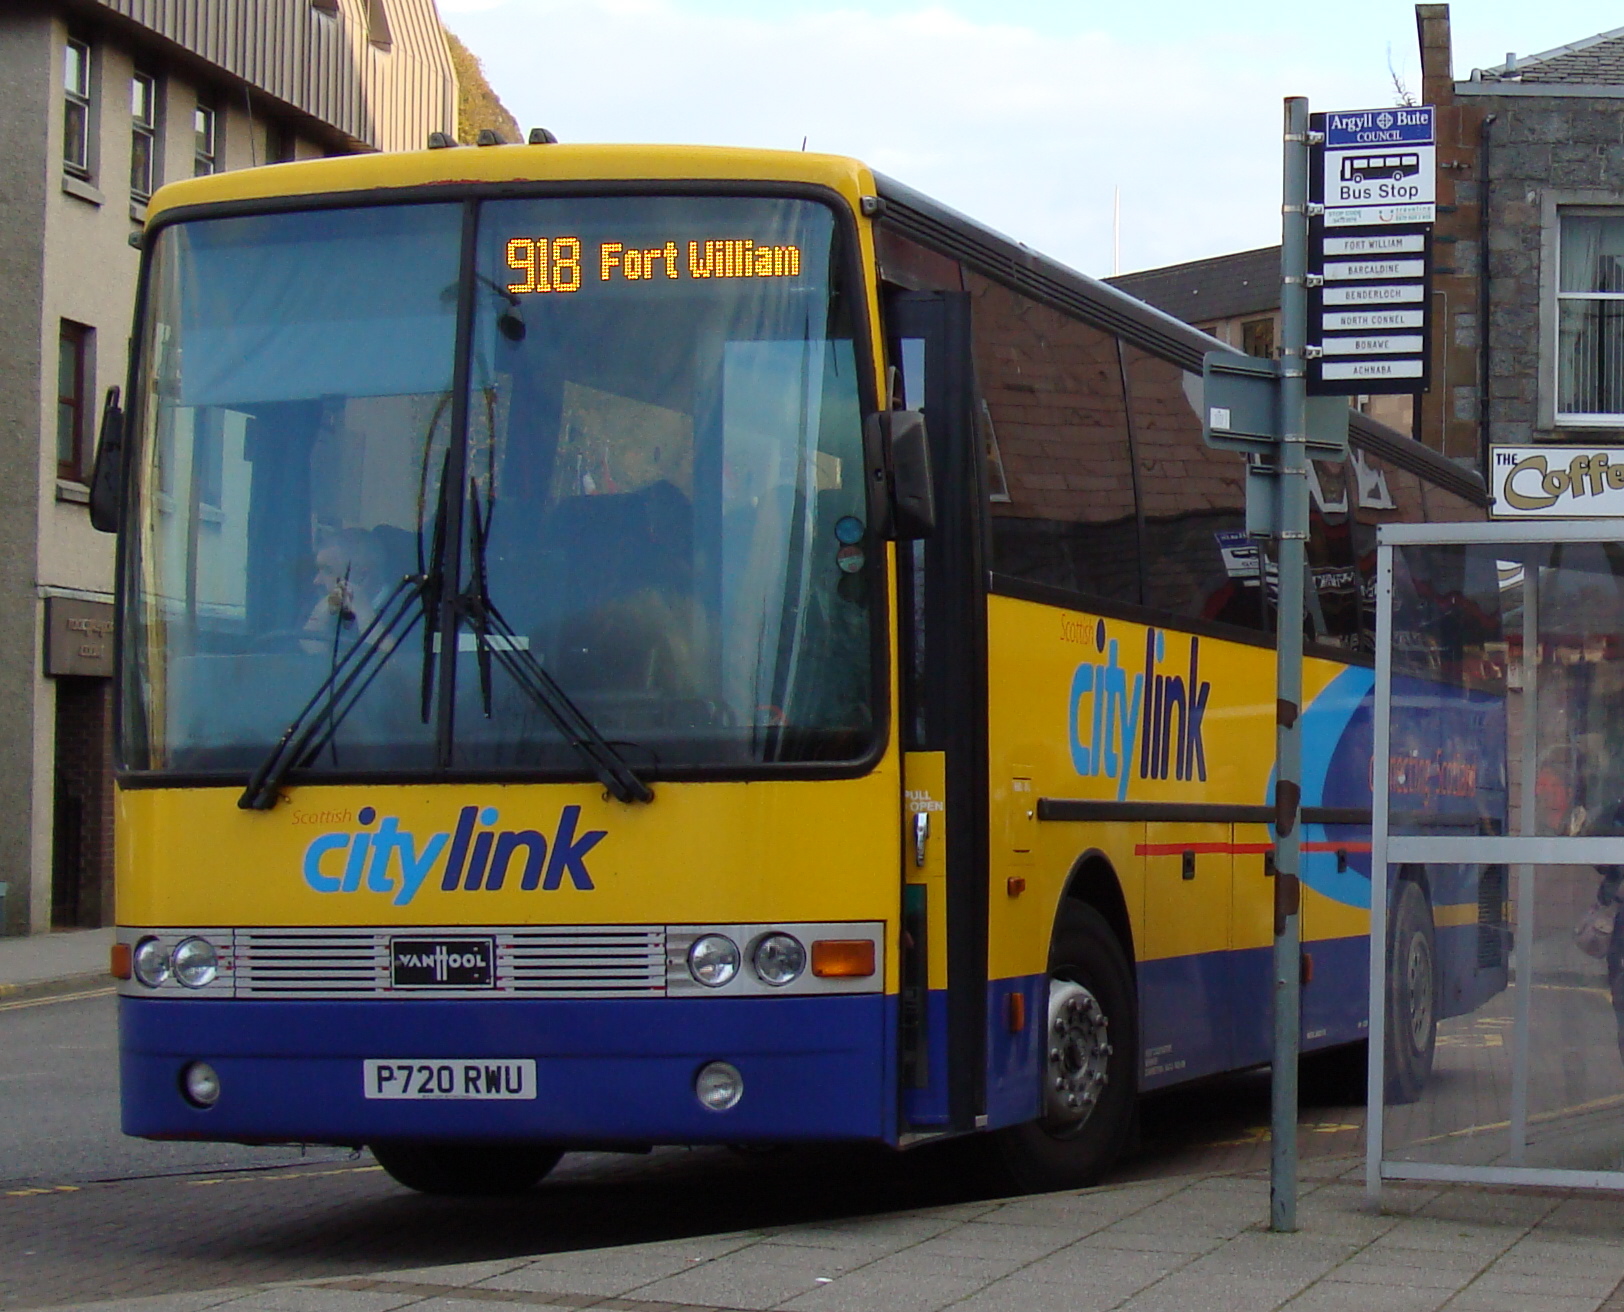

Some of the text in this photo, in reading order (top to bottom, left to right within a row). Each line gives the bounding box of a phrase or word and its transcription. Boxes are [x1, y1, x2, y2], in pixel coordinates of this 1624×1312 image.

[1331, 111, 1429, 132] Argyll Bute
[1356, 130, 1403, 142] COUNCIL
[1340, 183, 1419, 200] Bus Stop
[1344, 238, 1403, 250] FORT WILLIAM
[506, 237, 581, 293] 918
[600, 239, 800, 280] Fort William
[1348, 264, 1400, 275] BARCALDINE
[1345, 289, 1402, 300] BENDERLOCH
[1340, 314, 1405, 325] NORTH CONNEL
[1355, 340, 1389, 350] BONAWE
[1353, 365, 1392, 375] ACHNABA
[1496, 453, 1518, 466] THE
[1060, 613, 1094, 645] Scottish
[1068, 617, 1211, 802] citylink
[910, 801, 944, 812] OPEN
[292, 809, 352, 825] Scottish
[303, 805, 609, 906] citylink
[377, 1065, 523, 1094] P720 RWU
